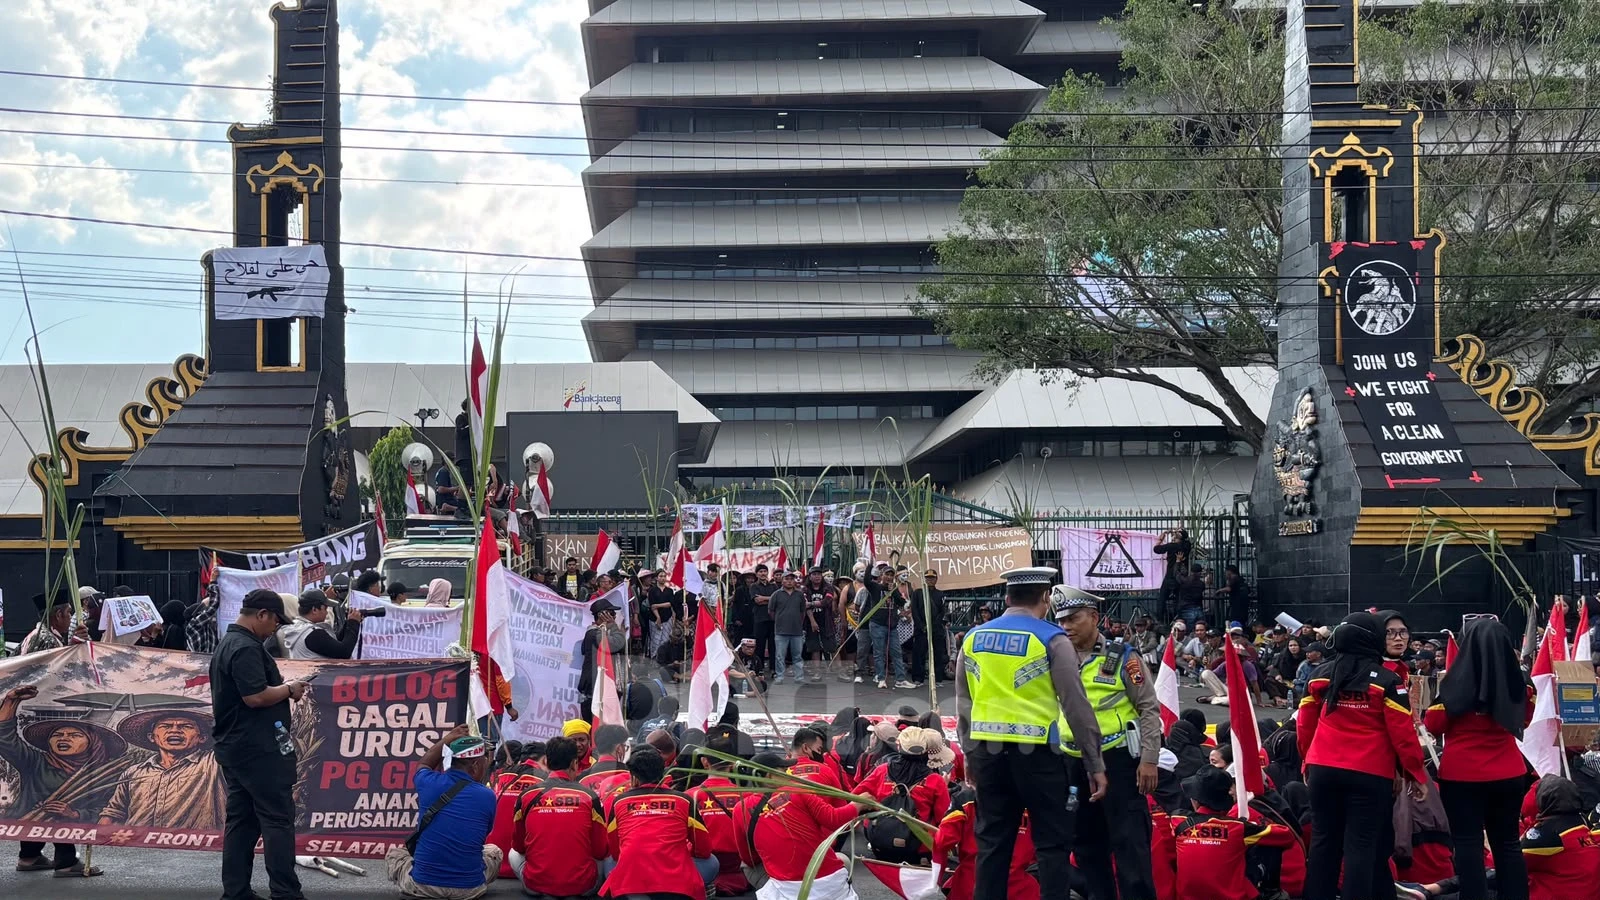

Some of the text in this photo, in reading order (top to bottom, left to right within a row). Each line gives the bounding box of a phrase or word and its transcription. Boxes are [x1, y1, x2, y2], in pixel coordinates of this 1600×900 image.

[1353, 352, 1417, 370] JOIN US
[1354, 379, 1430, 397] WE FIGHT
[1386, 401, 1416, 417] FOR
[1381, 423, 1444, 441] A CLEAN
[1381, 449, 1464, 466] GOVERNMENT
[989, 529, 1026, 538] KENDENG
[931, 552, 1015, 576] TAMBANG
[974, 632, 1025, 653] POLISI
[332, 669, 456, 703] BULOG
[337, 702, 456, 728] GAGAL
[340, 730, 449, 757] URUS
[320, 760, 370, 789] PG
[353, 793, 419, 810] ANAK
[27, 827, 98, 841] BLORA
[143, 831, 220, 847] FRONT
